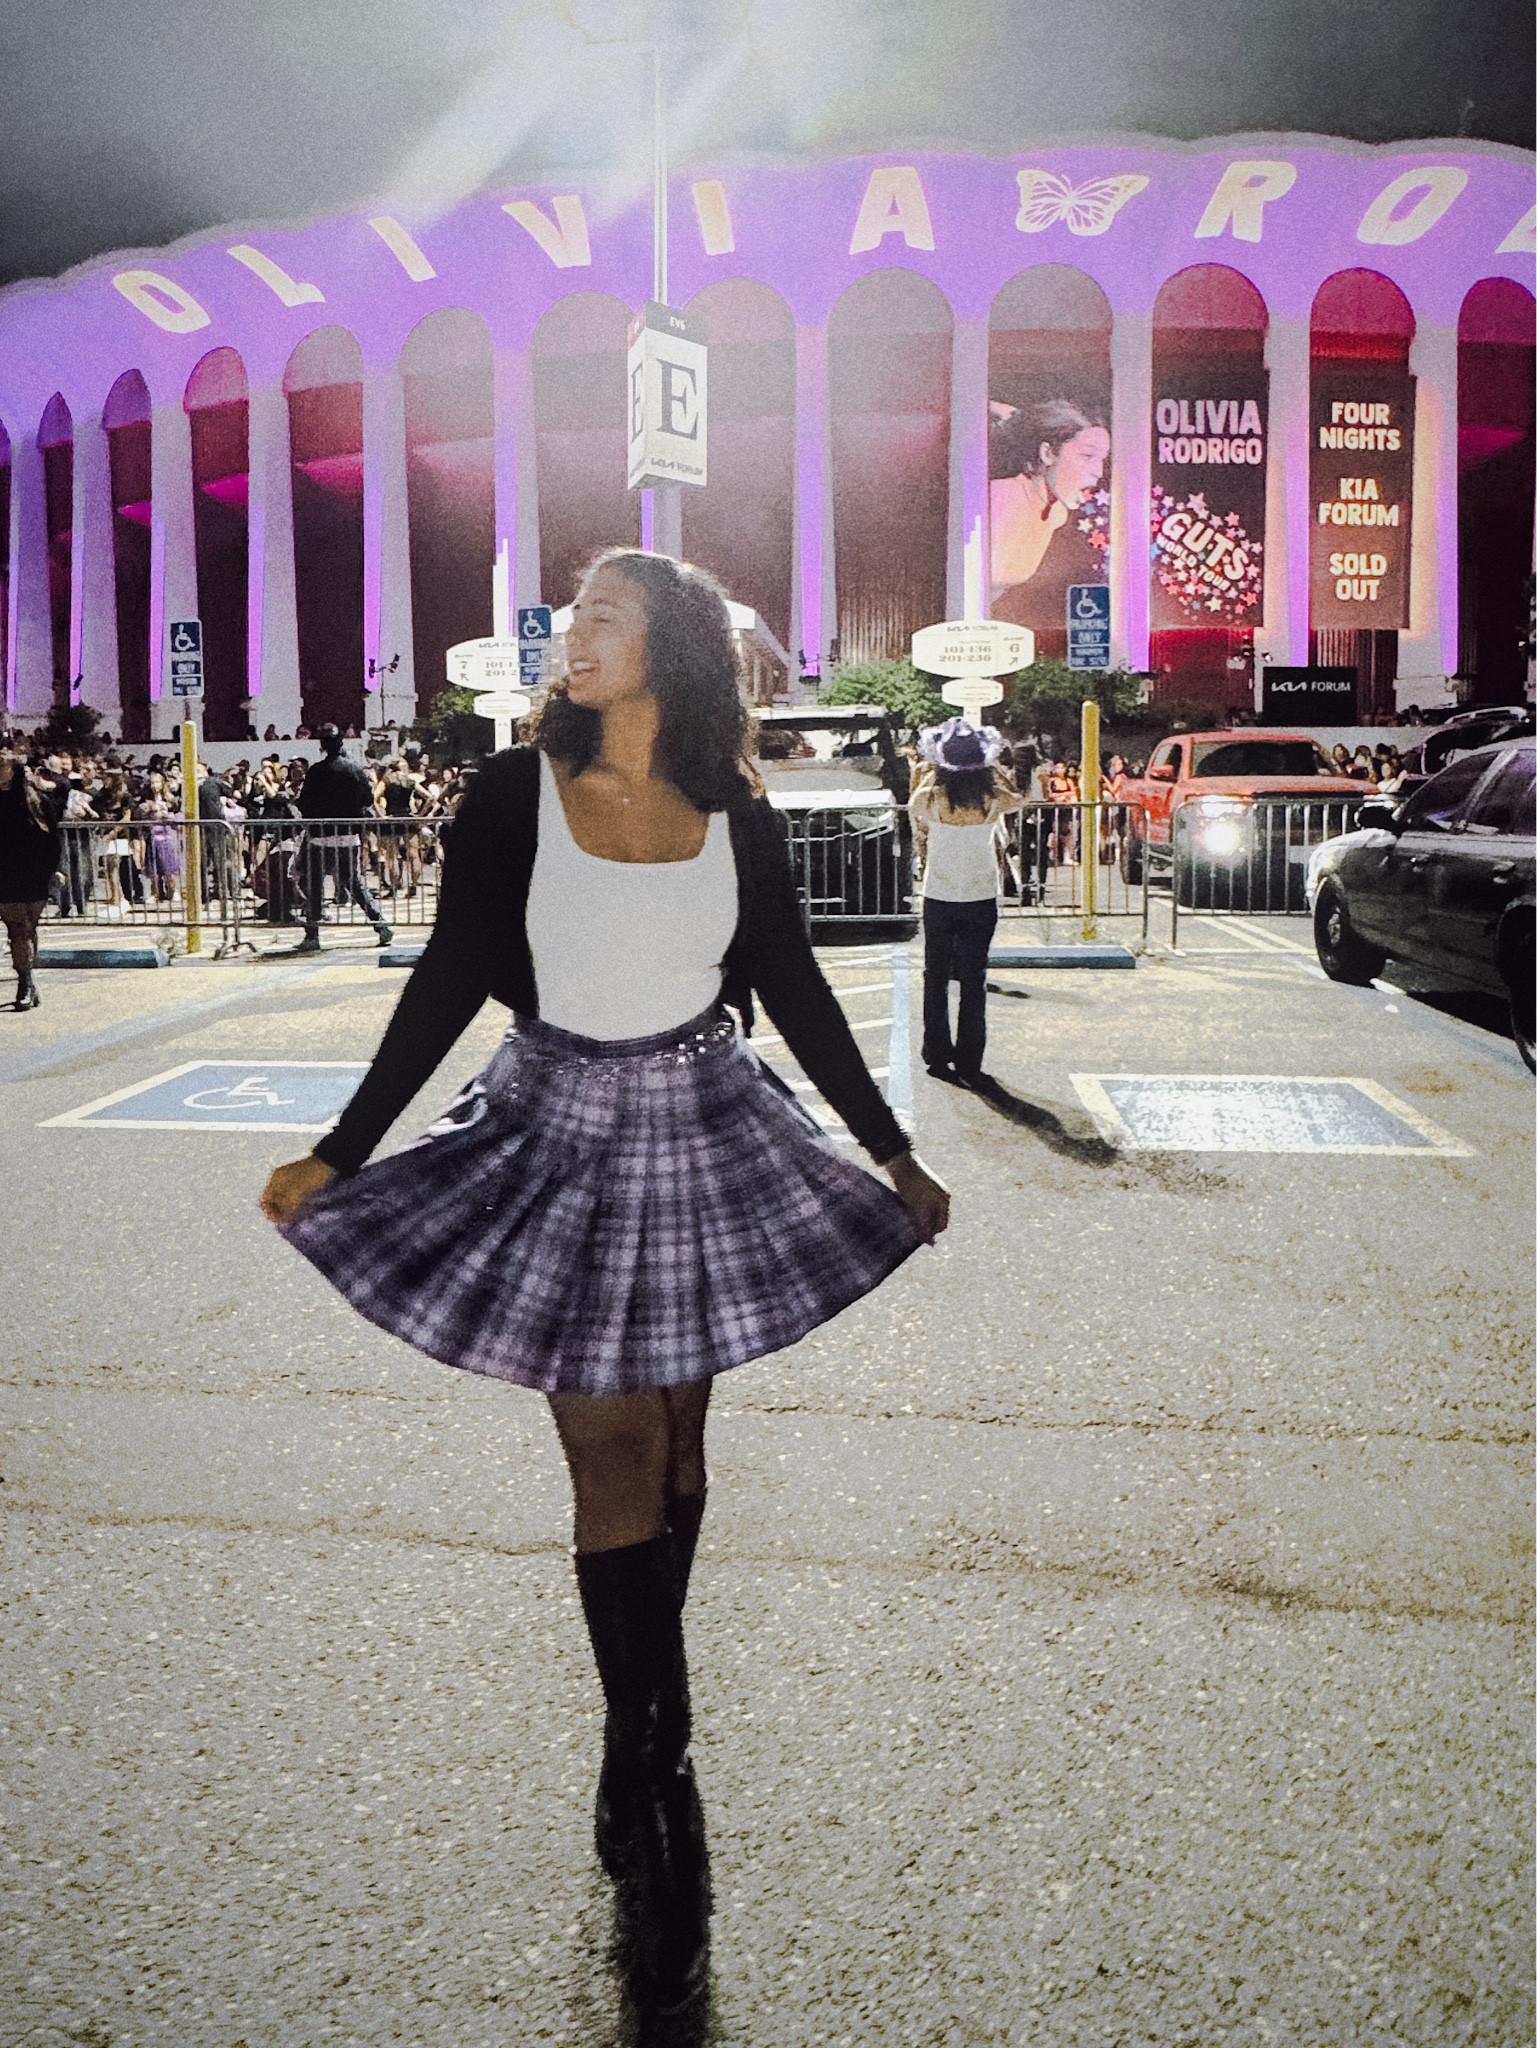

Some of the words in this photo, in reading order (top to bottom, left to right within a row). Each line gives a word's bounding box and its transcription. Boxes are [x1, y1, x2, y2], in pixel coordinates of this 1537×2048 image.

[111, 166, 936, 334] OLIVIA
[656, 358, 699, 441] E
[1156, 399, 1262, 435] OLIVIA
[1331, 401, 1390, 425] FOUR
[1158, 437, 1263, 465] RODRIGO
[1319, 427, 1401, 451] NIGHTS
[1339, 477, 1379, 500] KIA
[1318, 502, 1399, 526] FORUM
[1161, 512, 1250, 580] GUTS
[1156, 532, 1198, 568] WORLD
[1198, 564, 1231, 591] TOUR
[1329, 552, 1388, 577] SOLD
[1335, 578, 1380, 601] OUT
[1009, 643, 1020, 653] 6
[1271, 681, 1307, 692] KIA
[1310, 681, 1351, 692] FORUM
